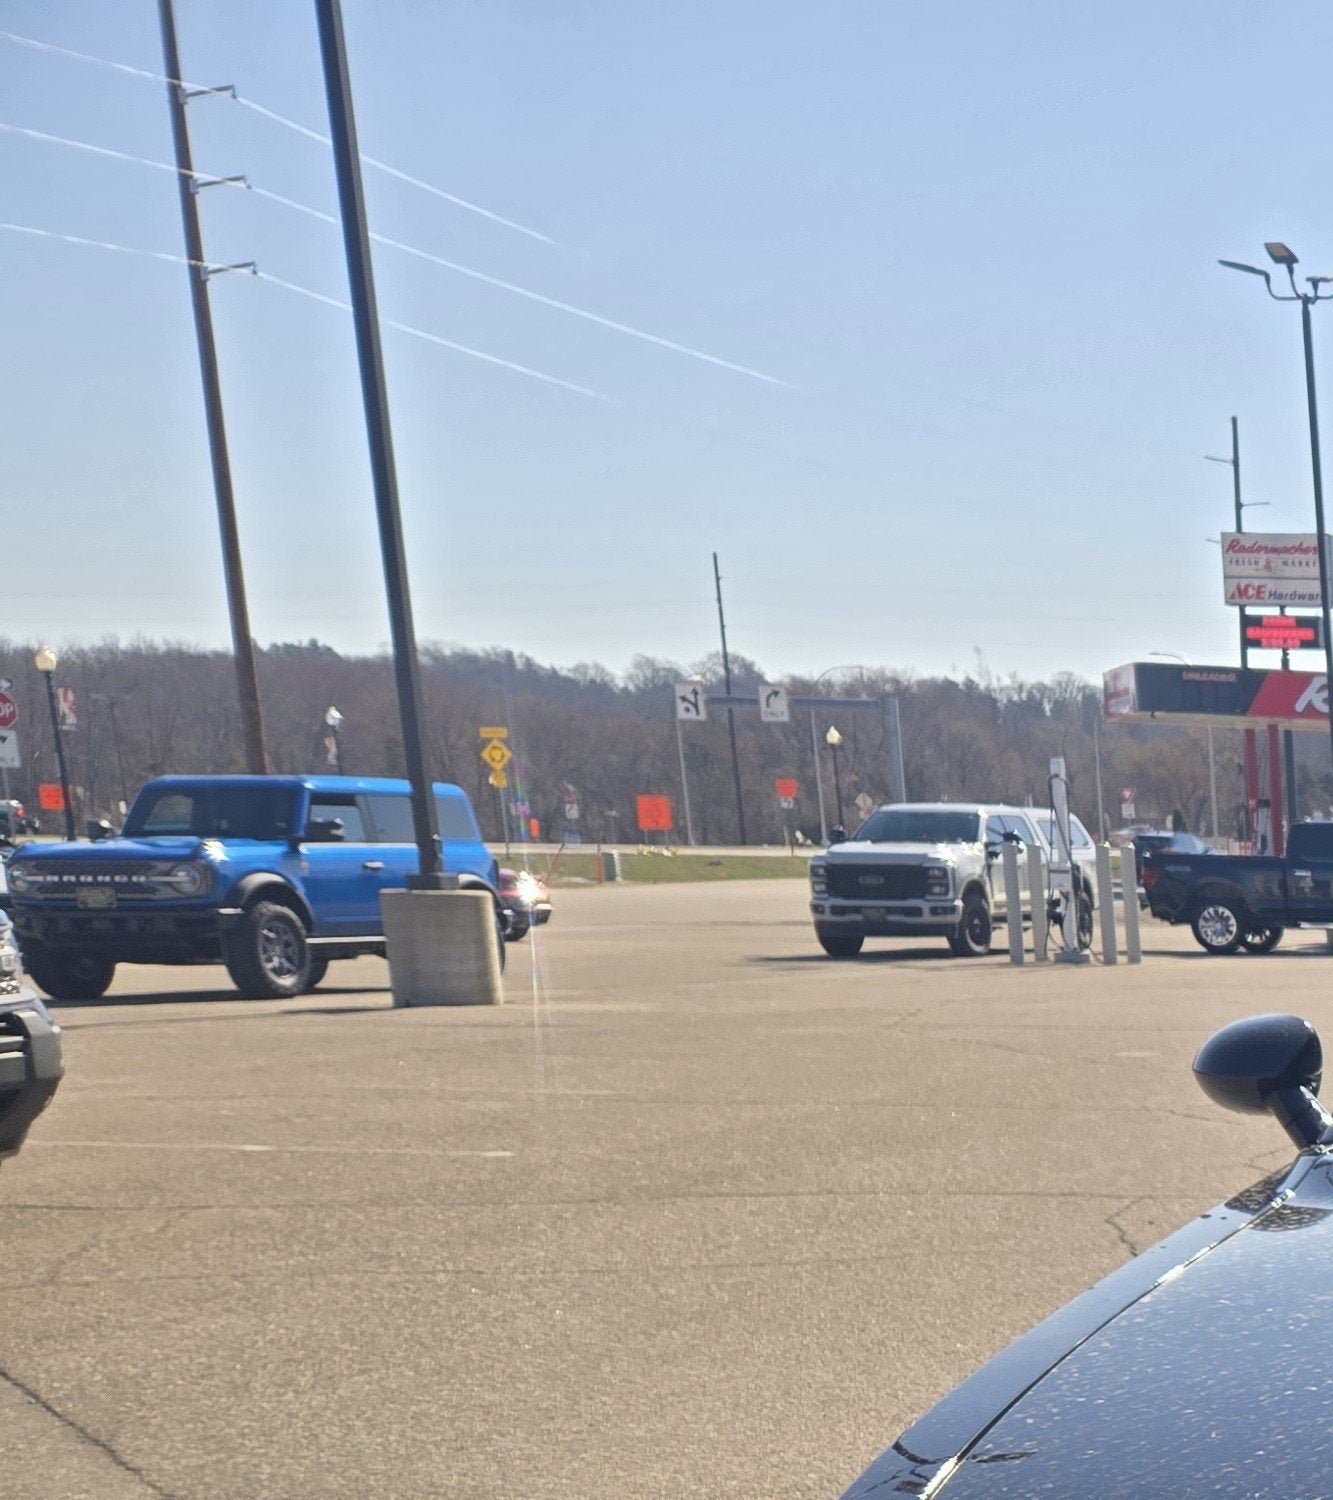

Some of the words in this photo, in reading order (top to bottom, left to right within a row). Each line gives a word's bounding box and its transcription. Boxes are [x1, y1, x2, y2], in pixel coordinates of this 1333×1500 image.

[1226, 538, 1319, 555] Radermacher
[1283, 558, 1317, 567] MARKE
[1229, 582, 1267, 600] ACE
[1268, 588, 1320, 601] Hardwar
